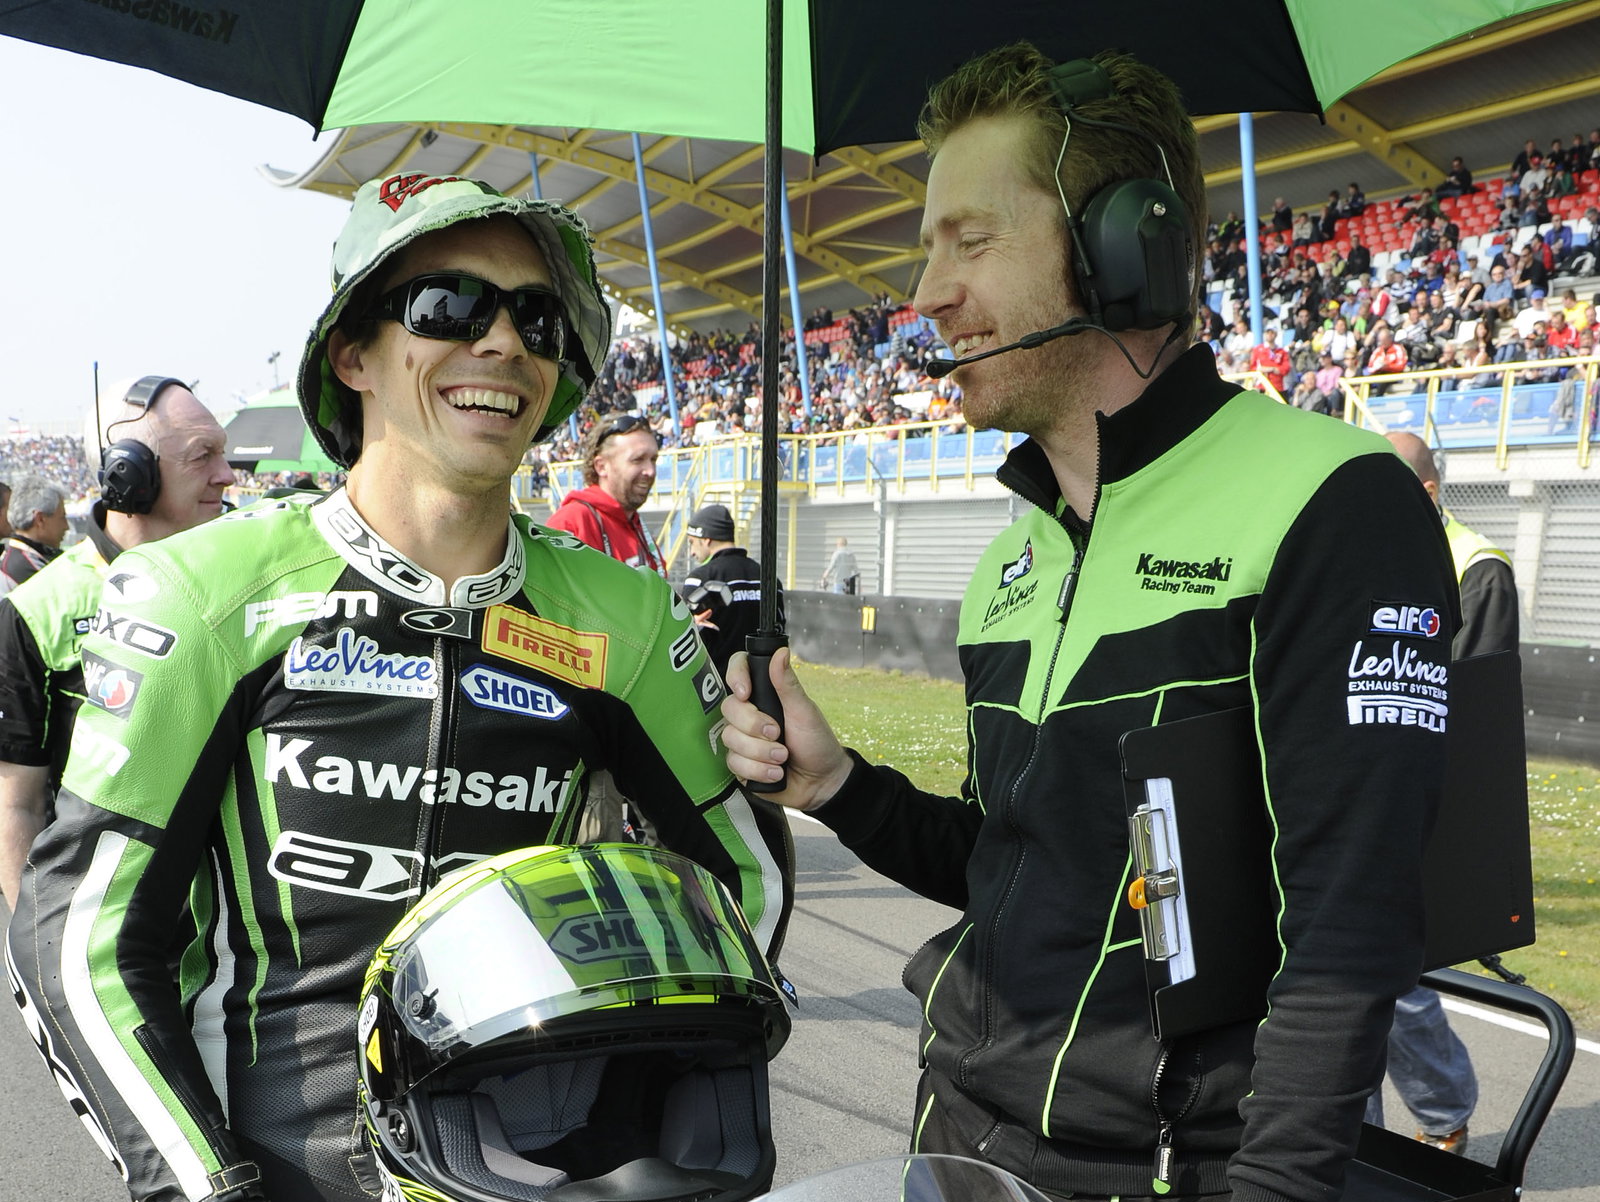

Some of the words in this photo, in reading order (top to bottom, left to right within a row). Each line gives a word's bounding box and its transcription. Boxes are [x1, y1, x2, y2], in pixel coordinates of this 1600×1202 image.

[1135, 552, 1233, 582] Kawasaki
[1141, 577, 1180, 595] Racing
[1181, 580, 1215, 595] Team
[1372, 605, 1421, 632] elf
[289, 631, 433, 681] LeoVince
[497, 617, 593, 674] PIRELLI
[1348, 640, 1448, 685] LeoVince
[289, 677, 356, 688] EXHAUST
[366, 681, 434, 695] SYSTEMS
[474, 673, 556, 714] SHOEI
[1348, 680, 1408, 692] EXHAUST
[1409, 683, 1448, 700] SYSTEMS
[1347, 694, 1448, 733] PIRELLI
[263, 732, 575, 813] Kawasaki
